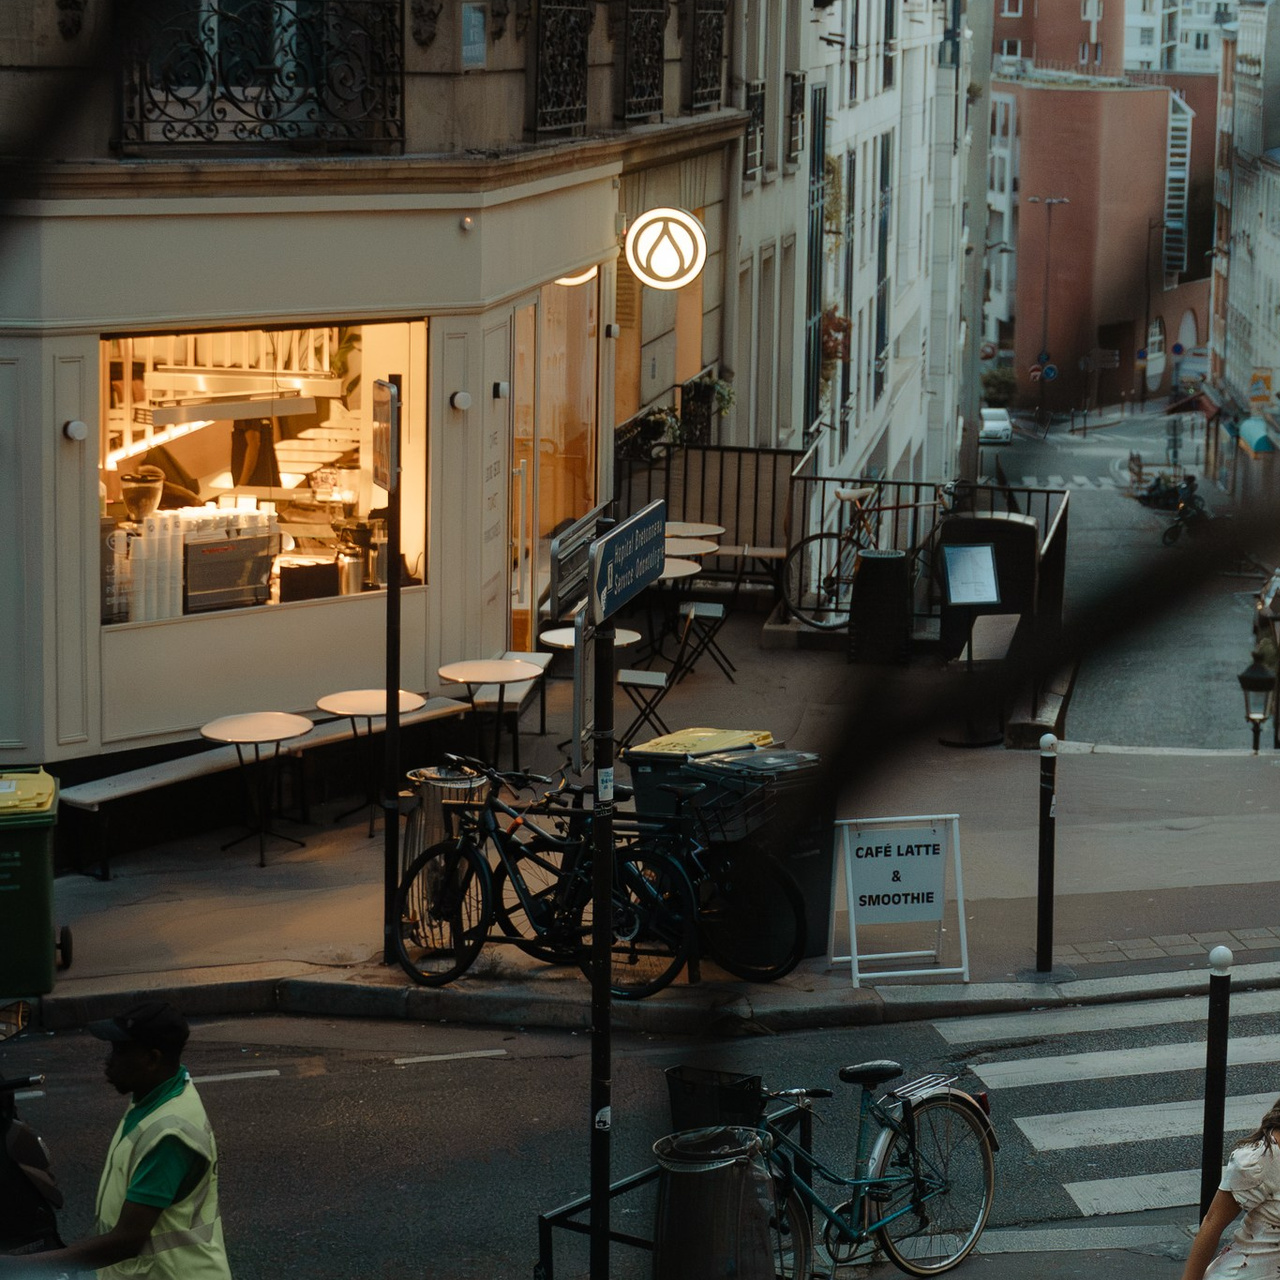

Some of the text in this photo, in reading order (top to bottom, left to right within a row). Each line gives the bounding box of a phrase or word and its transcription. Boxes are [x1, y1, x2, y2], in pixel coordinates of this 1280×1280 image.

[614, 566, 634, 596] Service
[855, 843, 941, 859] CAFÉ LATTE
[891, 870, 902, 882] &
[859, 892, 935, 907] SMOOTHIE
